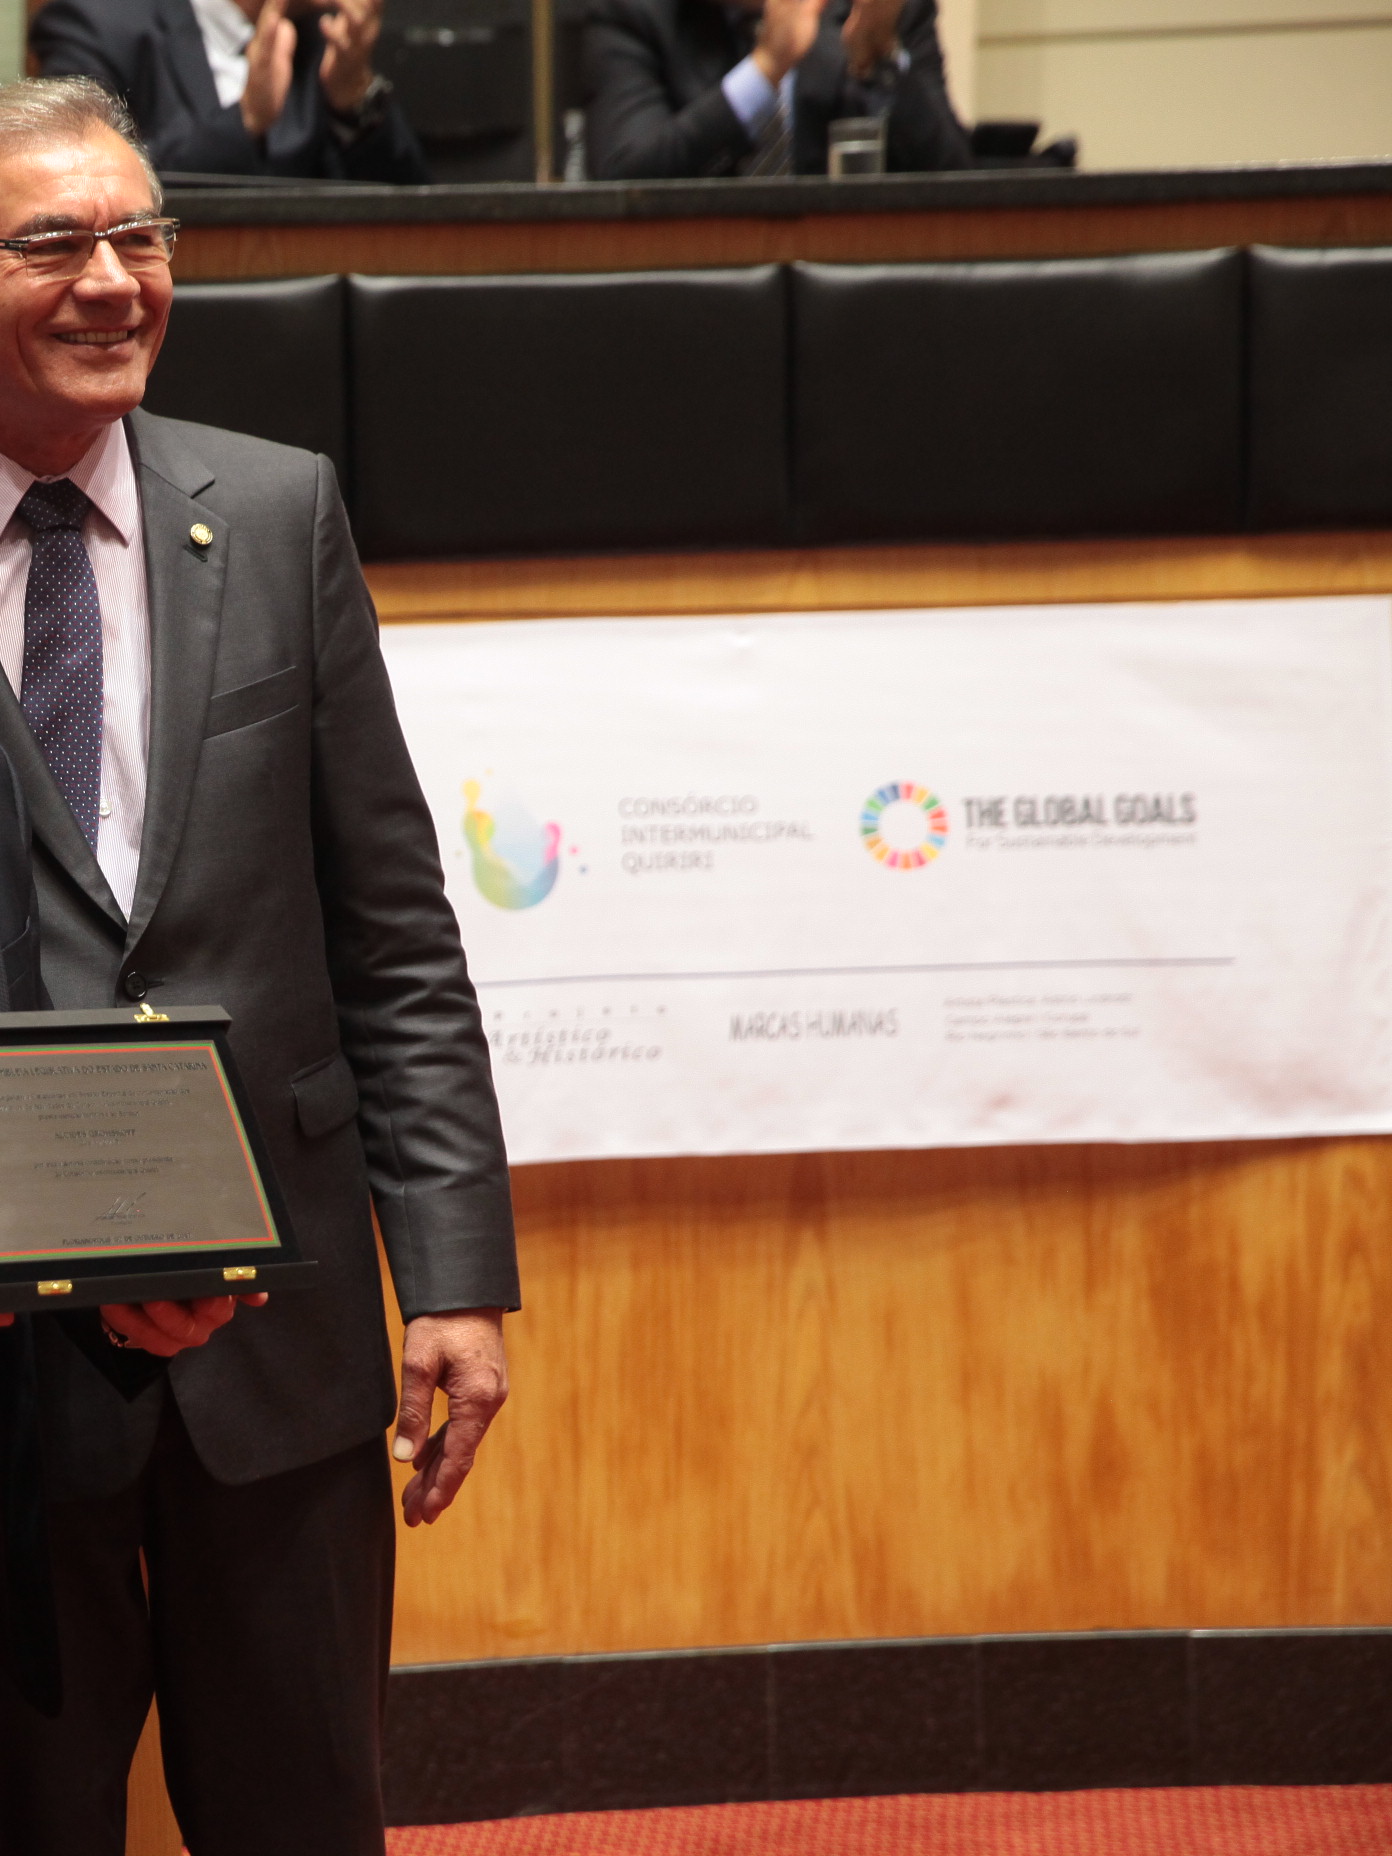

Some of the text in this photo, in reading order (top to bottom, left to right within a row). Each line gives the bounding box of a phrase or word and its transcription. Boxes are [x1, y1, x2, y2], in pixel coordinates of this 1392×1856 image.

[618, 791, 758, 818] CONSÓRCIO
[962, 792, 1197, 828] THE GLOBAL GOALS
[621, 820, 816, 845] INTERMUNICIPAL
[729, 1007, 900, 1041] MARCAS HUMANAS
